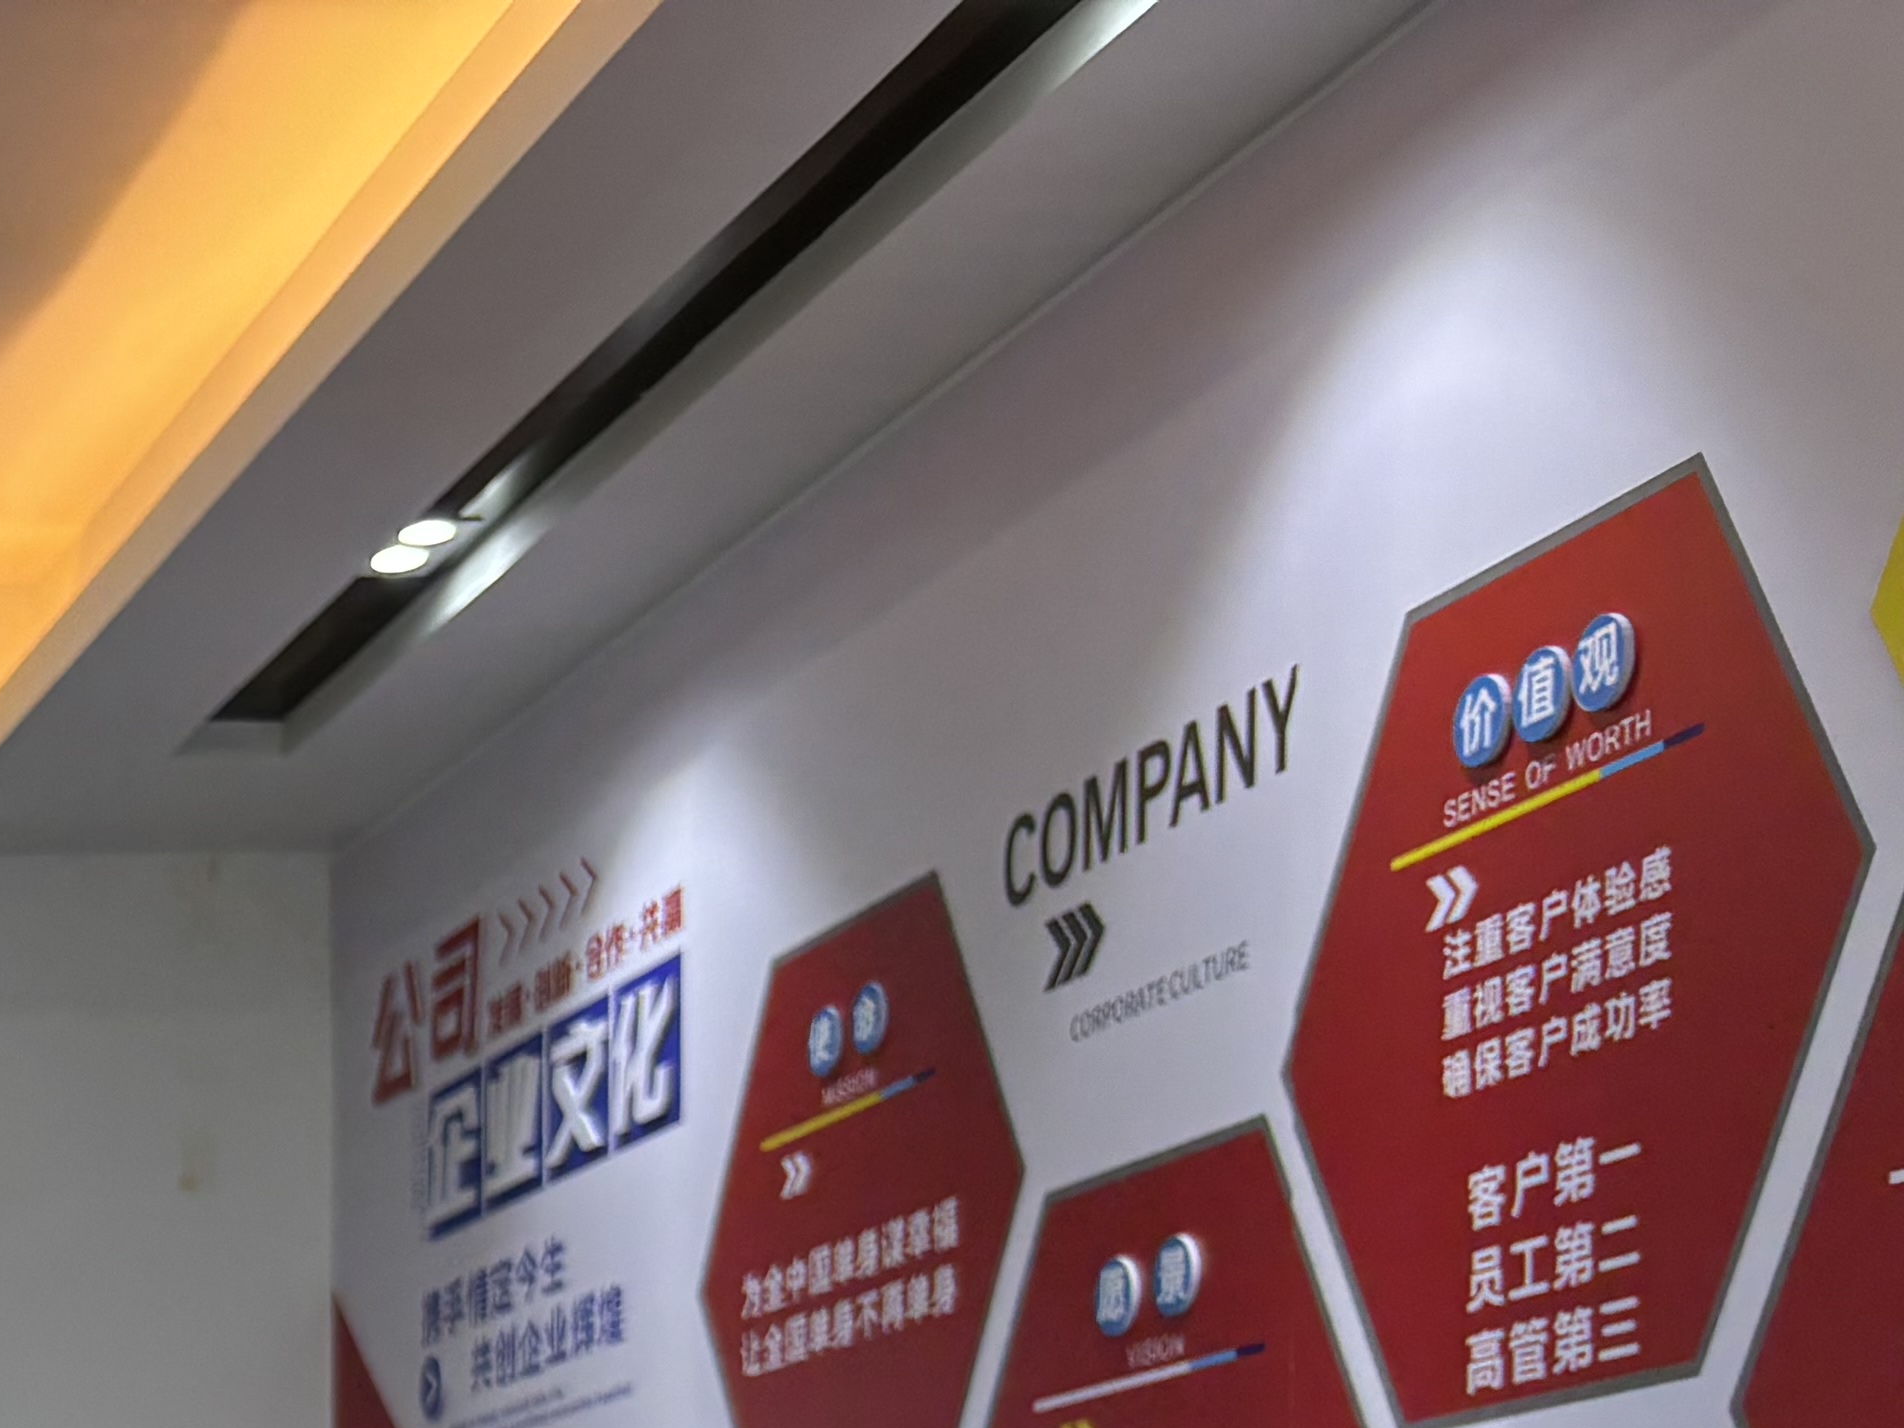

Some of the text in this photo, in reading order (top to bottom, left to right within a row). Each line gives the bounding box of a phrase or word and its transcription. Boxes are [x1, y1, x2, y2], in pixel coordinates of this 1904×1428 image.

[1456, 618, 1624, 760] 价值观
[1004, 664, 1301, 907] COMPANY
[1442, 709, 1653, 828] SENSE OF WORTH
[1441, 845, 1673, 981] 注重客户体验感
[371, 912, 485, 1108] 公司
[1069, 940, 1250, 1043] CORPORATE CULTURE
[1441, 911, 1673, 1042] 重视客户满意度
[1441, 977, 1673, 1099] 确保客户成功率
[426, 965, 680, 1232] 企业文化
[1465, 1136, 1642, 1232] 客户第一
[1465, 1215, 1641, 1314] 员工第二
[1465, 1296, 1641, 1397] 高管第三
